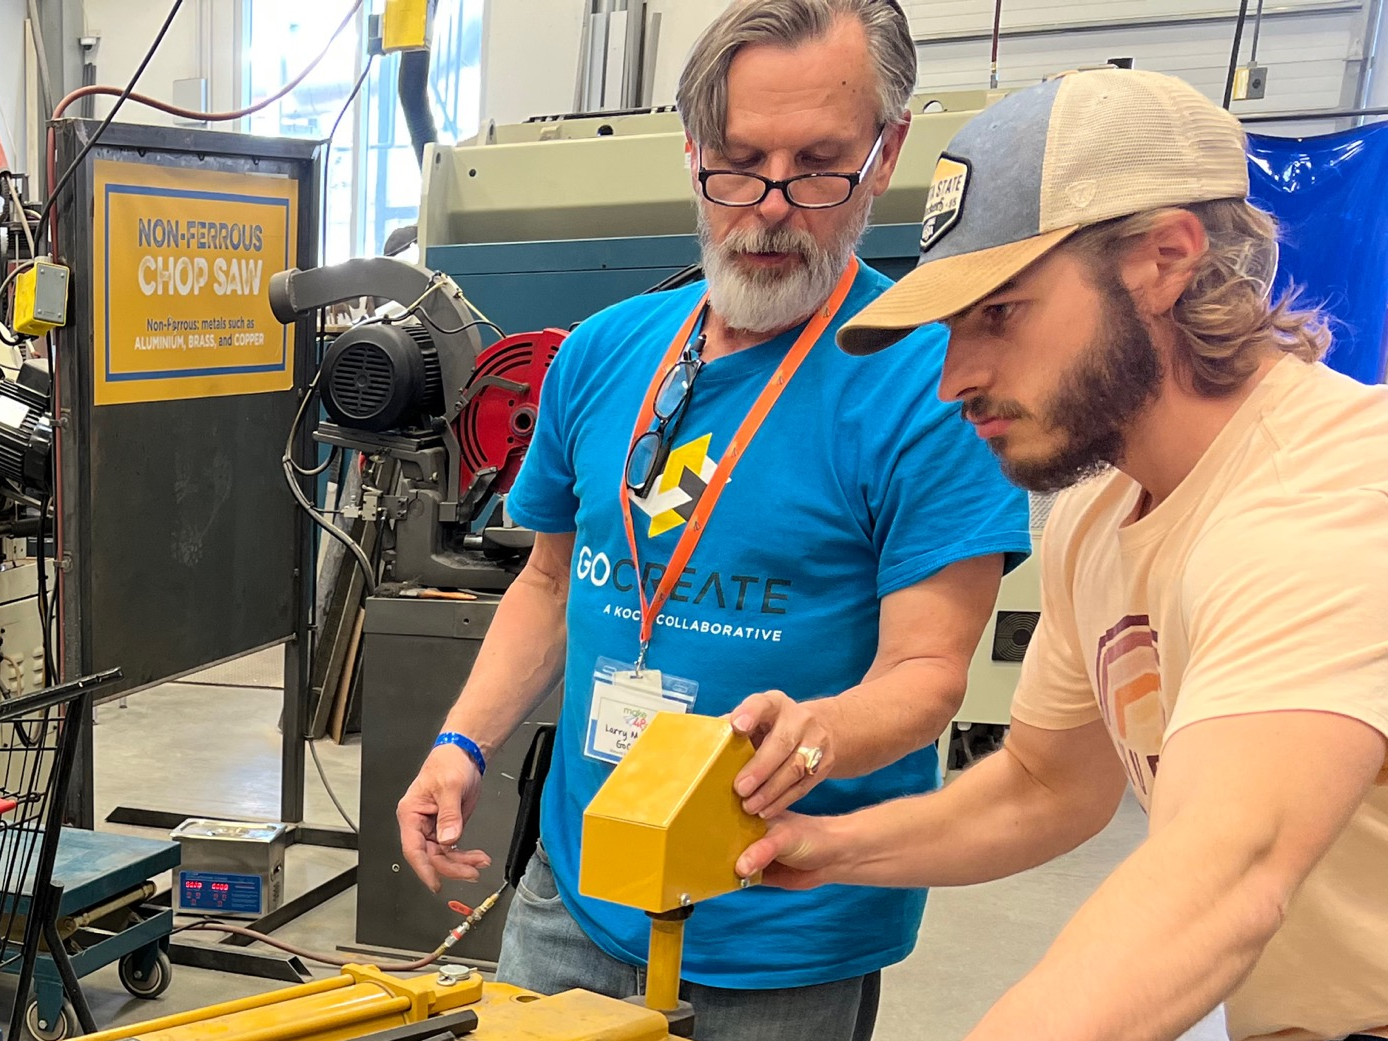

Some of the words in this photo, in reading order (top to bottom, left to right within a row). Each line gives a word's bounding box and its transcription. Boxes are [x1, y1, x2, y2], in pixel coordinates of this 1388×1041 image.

[138, 217, 263, 252] NON-FERROUS
[137, 255, 209, 296] CHOP
[213, 257, 263, 296] SAW
[146, 317, 199, 332] Non-Ferrous:
[201, 317, 226, 330] metals
[228, 316, 244, 329] such
[246, 318, 255, 329] as
[188, 334, 217, 349] BRASS,
[218, 335, 232, 346] and
[233, 332, 264, 346] COPPER
[602, 603, 611, 615] A
[613, 605, 643, 621] KOC
[655, 613, 783, 642] COLLABORATIVE
[623, 706, 648, 719] make
[605, 723, 628, 742] Larry
[615, 739, 632, 750] GoC
